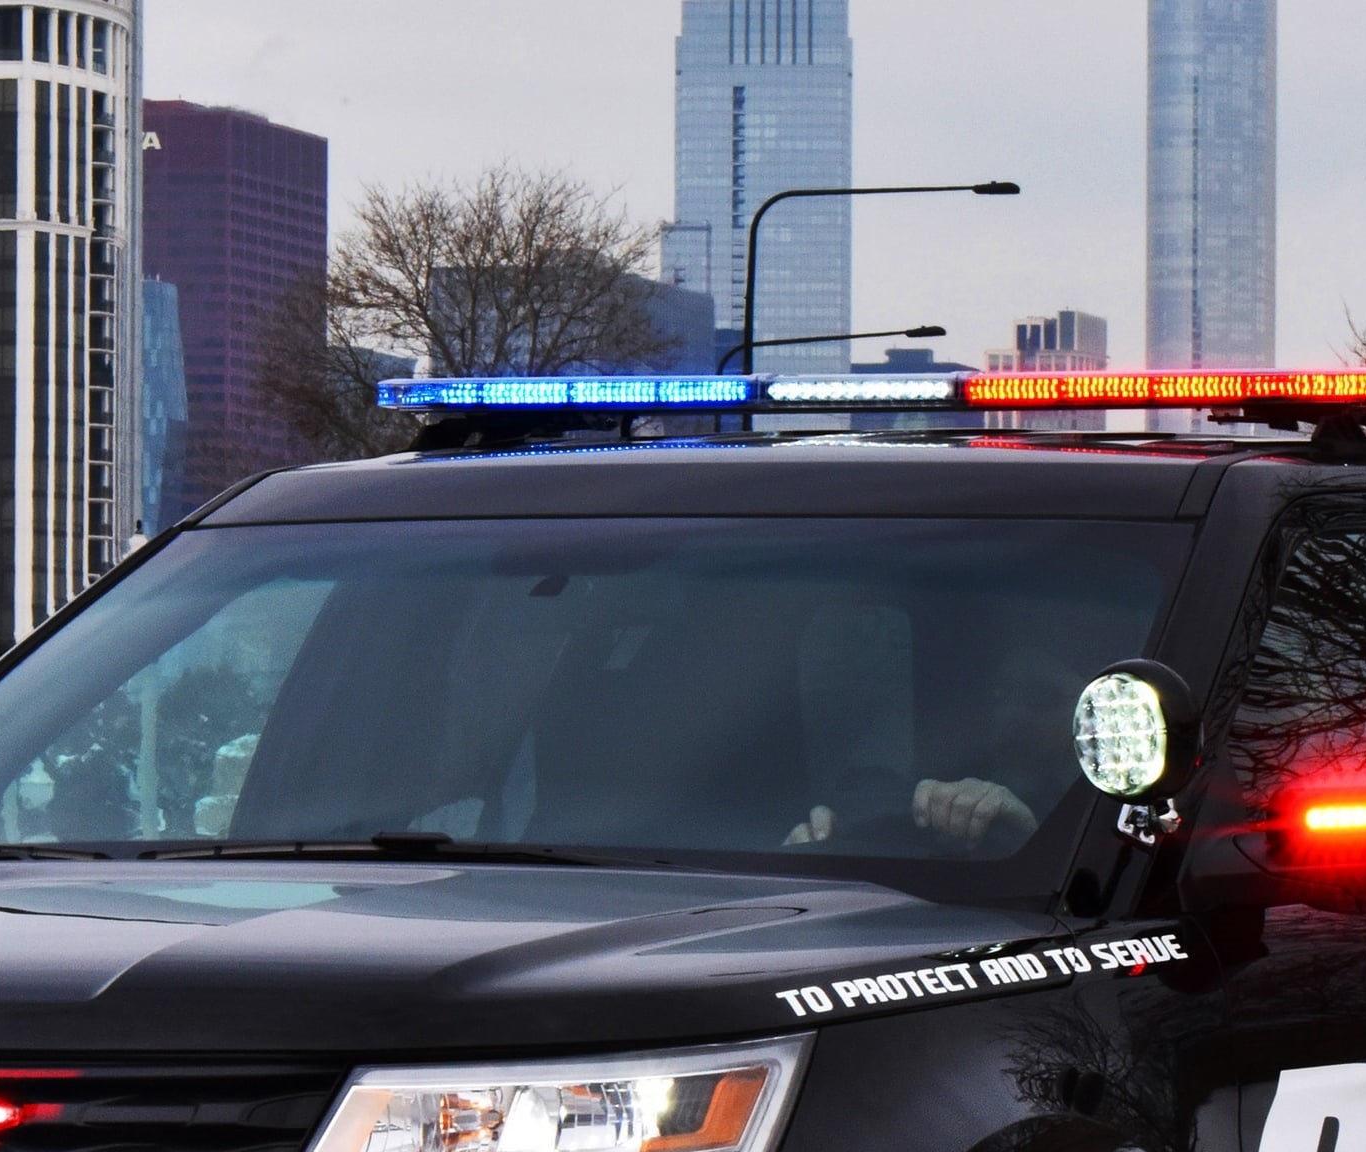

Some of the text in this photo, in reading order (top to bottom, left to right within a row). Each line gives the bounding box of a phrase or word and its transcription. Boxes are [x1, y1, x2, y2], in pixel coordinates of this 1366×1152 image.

[142, 131, 162, 150] A
[776, 934, 1189, 1016] TO PROTECT AND TO SERVE
